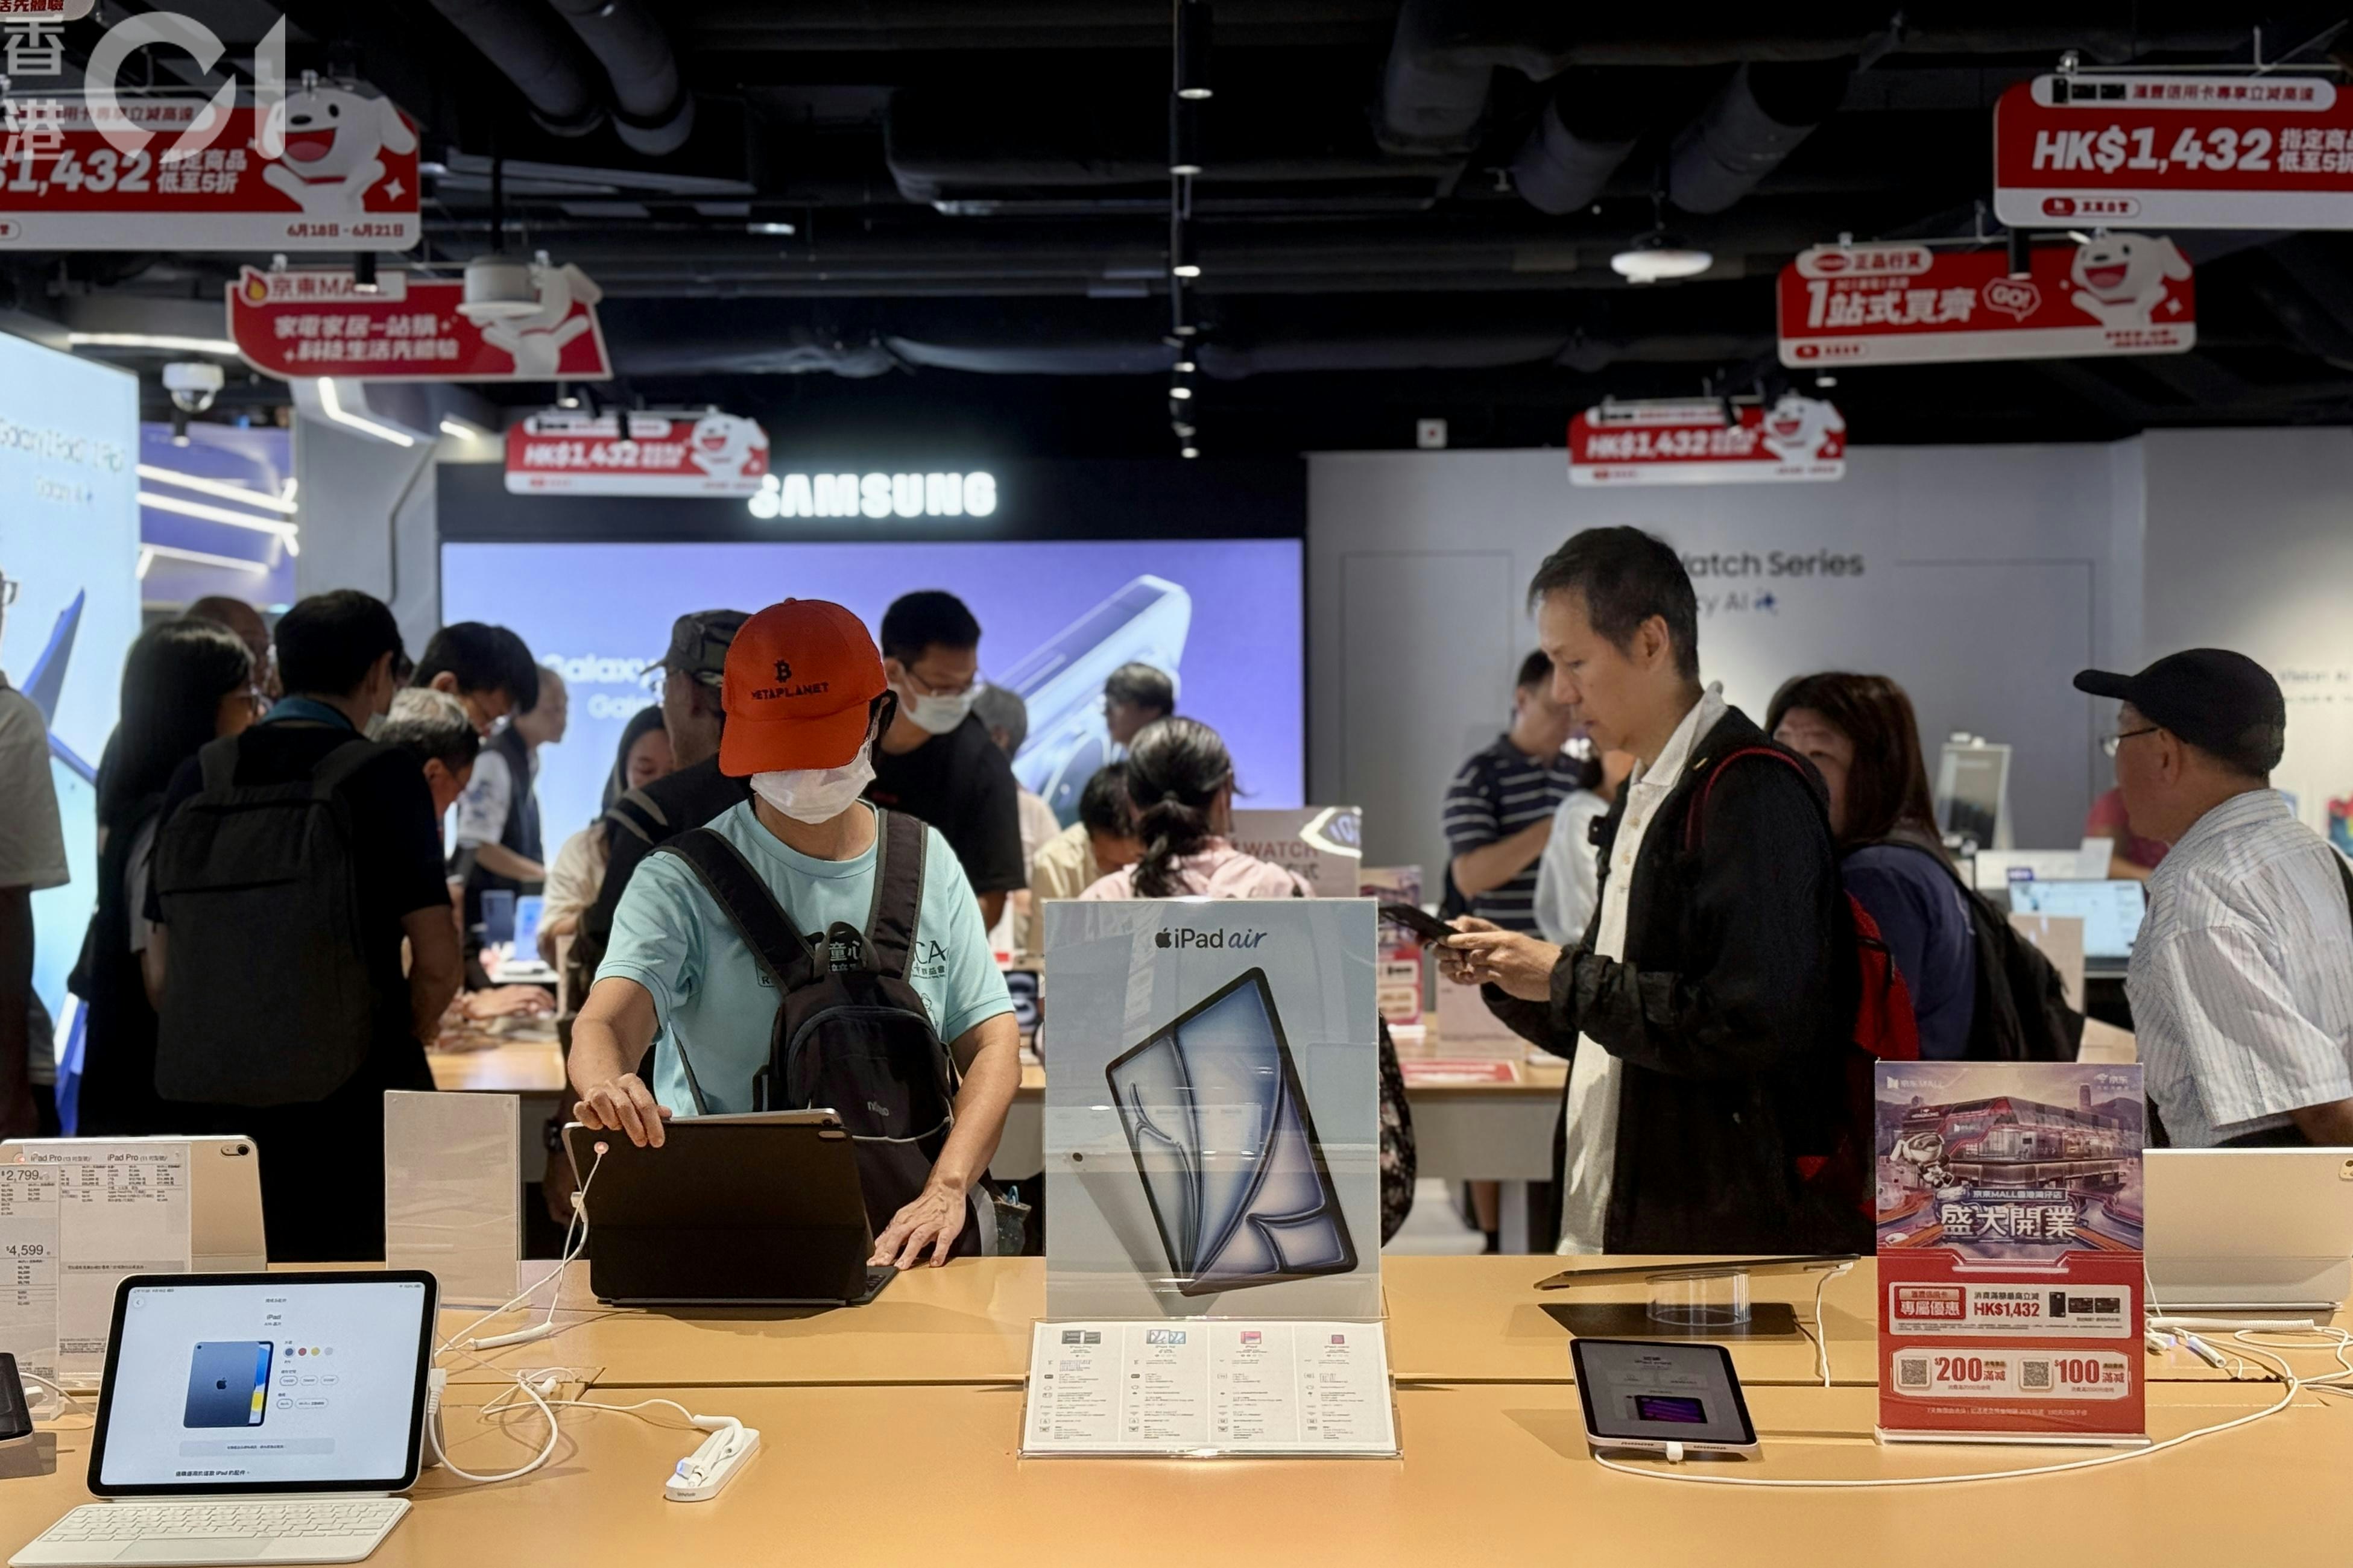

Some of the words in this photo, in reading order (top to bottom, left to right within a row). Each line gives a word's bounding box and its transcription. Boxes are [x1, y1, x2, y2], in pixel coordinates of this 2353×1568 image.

[2032, 125, 2272, 174] HK$1,432
[0, 148, 152, 197] 1,432
[157, 172, 239, 194] 低至5折
[287, 224, 340, 238] 6月18日
[352, 224, 404, 238] 6月21日
[271, 277, 387, 297] 京東MA
[748, 472, 997, 518] SAMSUNG
[1681, 551, 1761, 578] atch
[1767, 548, 1865, 577] Series
[1243, 841, 1319, 858] WATCH
[1175, 928, 1224, 949] iPad
[1228, 929, 1268, 949] air
[1, 1170, 39, 1182] $2,799
[1941, 1205, 2076, 1238] 盛大開業
[6, 1244, 44, 1258] $4,599
[1974, 1302, 2040, 1318] HK$1,432
[1935, 1357, 1982, 1382] $200
[2055, 1359, 2100, 1384] $100
